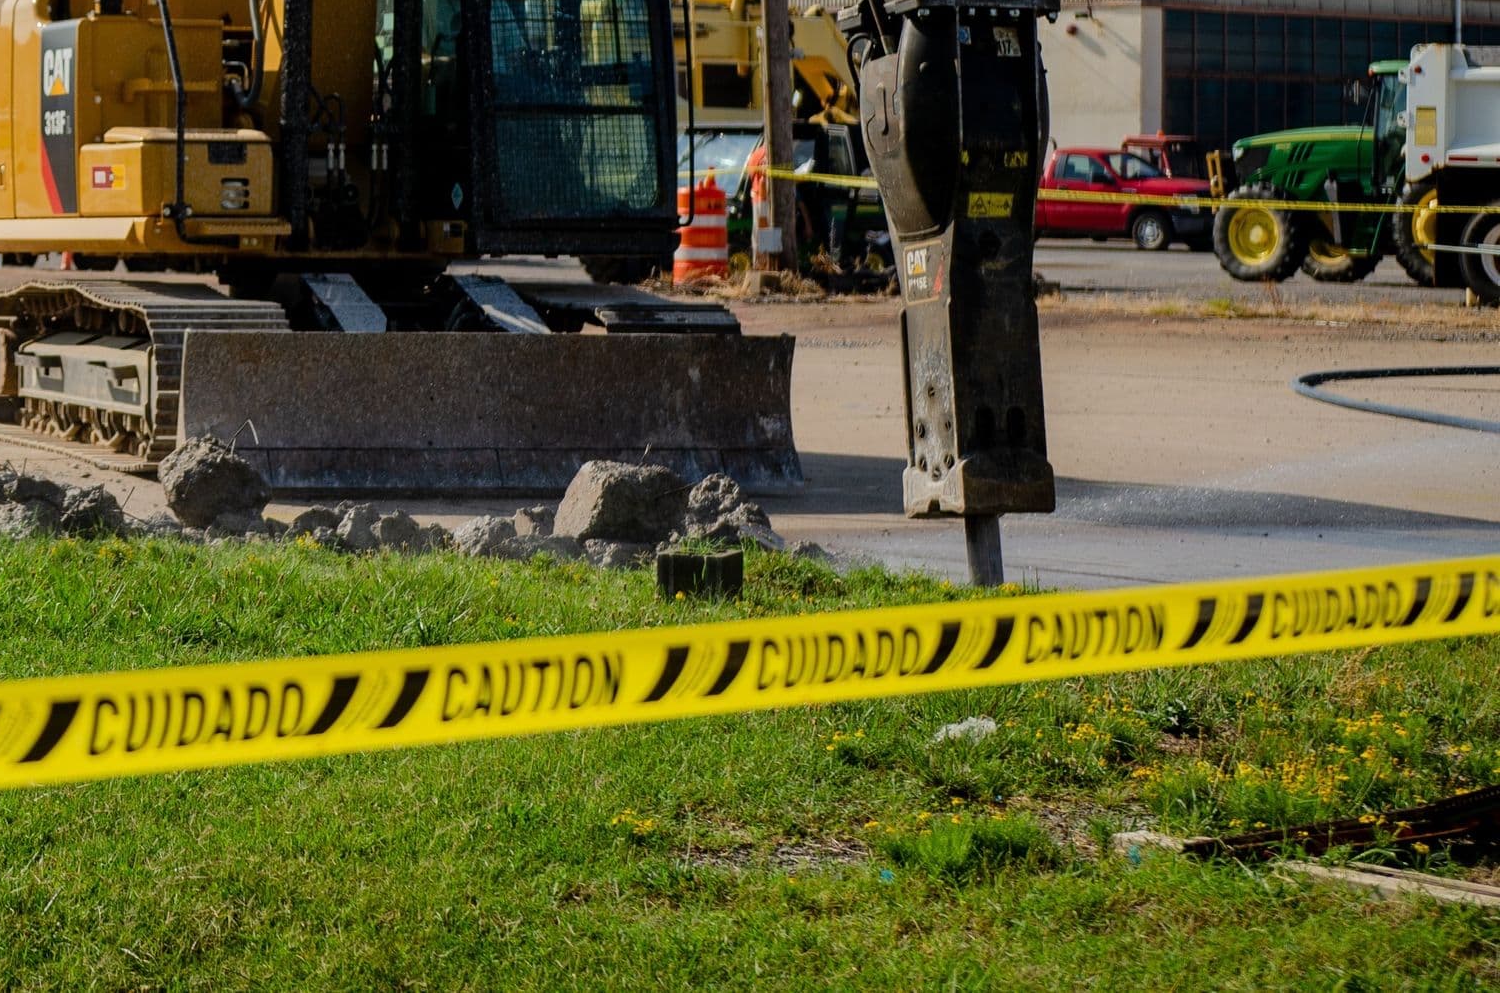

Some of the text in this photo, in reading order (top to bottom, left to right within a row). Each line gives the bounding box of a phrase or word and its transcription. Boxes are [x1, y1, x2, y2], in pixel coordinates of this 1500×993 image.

[43, 47, 73, 97] CAT
[907, 248, 928, 276] CAT
[88, 681, 306, 756] CUIDADO
[442, 655, 621, 722] CAUTION
[756, 627, 921, 691] CUIDADO
[1025, 605, 1166, 665] CAUTION
[1270, 581, 1401, 640] CUIDADO
